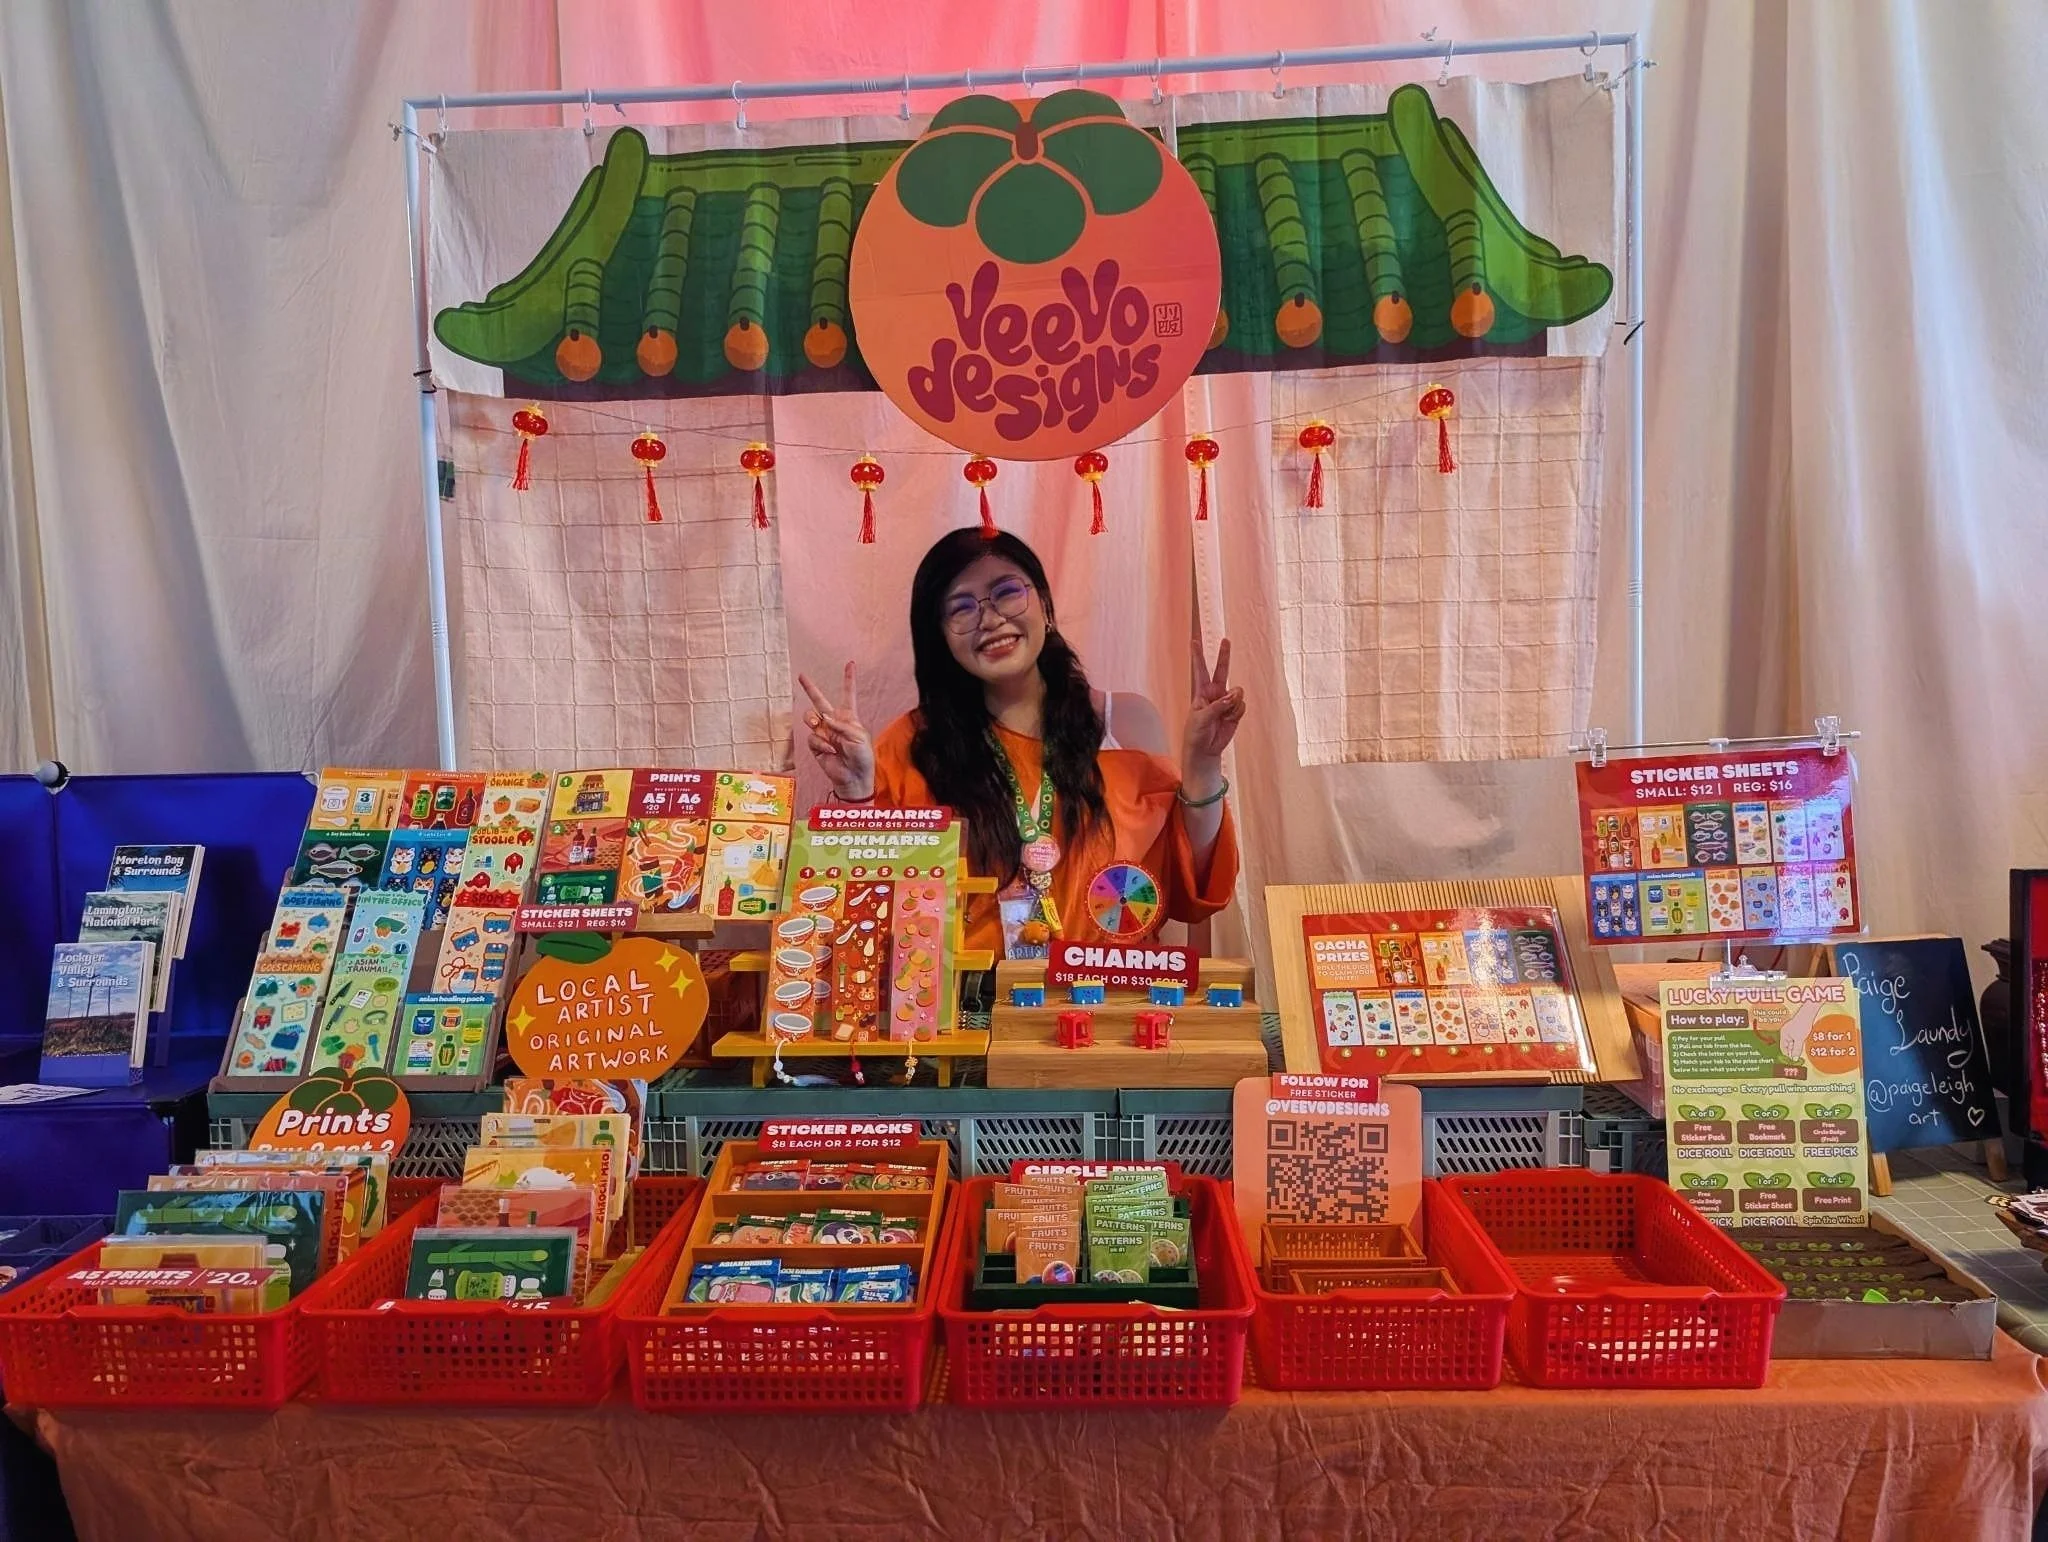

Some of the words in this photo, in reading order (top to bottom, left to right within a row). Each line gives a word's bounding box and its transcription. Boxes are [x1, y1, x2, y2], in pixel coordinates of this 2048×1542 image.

[1630, 766, 1719, 785] STICKER
[1722, 761, 1798, 780] SHEETS
[650, 774, 701, 783] PRINTS
[723, 776, 729, 784] 5
[1636, 787, 1686, 799] SMALL:
[1690, 784, 1713, 796] $12
[1733, 781, 1766, 792] REG:
[1770, 780, 1792, 791] $16
[642, 793, 666, 803] A5
[677, 792, 701, 804] A6
[819, 809, 943, 820] BOOKMARKS
[716, 826, 722, 834] 6
[811, 836, 940, 846] BOOKMARKS
[849, 849, 899, 859] ROLL
[165, 855, 184, 867] Bay
[124, 866, 181, 875] Surrounds
[855, 868, 862, 876] 2
[882, 868, 889, 876] 5
[908, 868, 915, 876] 3
[934, 868, 941, 876] 6
[521, 909, 581, 919] STICKER
[583, 907, 633, 918] SHEETS
[132, 916, 160, 926] Park
[558, 920, 574, 928] $12
[1314, 940, 1367, 950] GACHA
[59, 953, 104, 965] Lockyer
[1065, 946, 1186, 971] CHARMS
[1317, 952, 1369, 962] PRIZES
[59, 963, 95, 977] Valley
[57, 979, 64, 987] &
[68, 977, 128, 987] Surrounds
[1055, 972, 1074, 982] $18
[1112, 975, 1127, 985] OR
[1131, 976, 1152, 986] $30
[1181, 979, 1188, 987] 2
[1843, 952, 1911, 1014] Paige
[537, 970, 650, 1005] LOCAL
[440, 996, 467, 1004] healing
[468, 996, 485, 1004] pack
[1669, 989, 1730, 1005] LUCKY
[1736, 988, 1784, 1003] PULL
[1787, 986, 1845, 1003] GAME
[558, 994, 654, 1024] ARTIST
[1671, 1015, 1696, 1025] How
[1700, 1016, 1713, 1024] to
[1716, 1014, 1745, 1026] play:
[530, 1021, 663, 1049] ORIGINAL
[1812, 1032, 1825, 1042] $8
[1827, 1032, 1844, 1041] for
[1846, 1032, 1851, 1041] 1
[1810, 1048, 1827, 1057] $12
[1830, 1048, 1846, 1056] for
[1848, 1048, 1855, 1056] 2
[550, 1044, 668, 1072] ARTWORK
[1281, 1076, 1338, 1087] FOLLOW
[1341, 1077, 1369, 1089] FOR
[1315, 1090, 1356, 1099] STICKER
[1673, 1086, 1685, 1094] No
[1687, 1086, 1732, 1095] exchanges
[1742, 1085, 1767, 1095] Every
[1769, 1085, 1786, 1094] pull
[1787, 1085, 1806, 1093] wins
[1808, 1084, 1855, 1094] something!
[1867, 1069, 1974, 1113] @paigeleigh
[277, 1107, 391, 1136] Prints
[1909, 1109, 1940, 1126] art
[767, 1124, 848, 1136] STICKER
[851, 1123, 913, 1134] PACKS
[772, 1140, 786, 1148] $8
[789, 1140, 822, 1148] EACH
[825, 1139, 842, 1147] OR
[845, 1139, 852, 1147] 2
[855, 1139, 878, 1147] FOR
[881, 1139, 901, 1147] $12
[1678, 1148, 1702, 1158] DICE
[1704, 1148, 1732, 1158] ROLL
[1740, 1148, 1764, 1158] DICE
[1766, 1148, 1794, 1158] ROLL
[1804, 1148, 1830, 1157] FREE
[1832, 1147, 1857, 1157] PICK
[1005, 1187, 1039, 1196] FRUITS
[1096, 1220, 1145, 1231] PATTERNS
[1742, 1217, 1767, 1227] DICE
[1768, 1217, 1797, 1227] ROLL
[1803, 1217, 1821, 1226] Spin
[1822, 1216, 1837, 1224] the
[1838, 1216, 1865, 1224] Wheel
[1032, 1229, 1067, 1237] FRUITS
[1029, 1242, 1065, 1250] FRUITS
[1092, 1237, 1142, 1245] PATTERNS
[67, 1271, 101, 1279] A5
[104, 1271, 192, 1279] PRINTS
